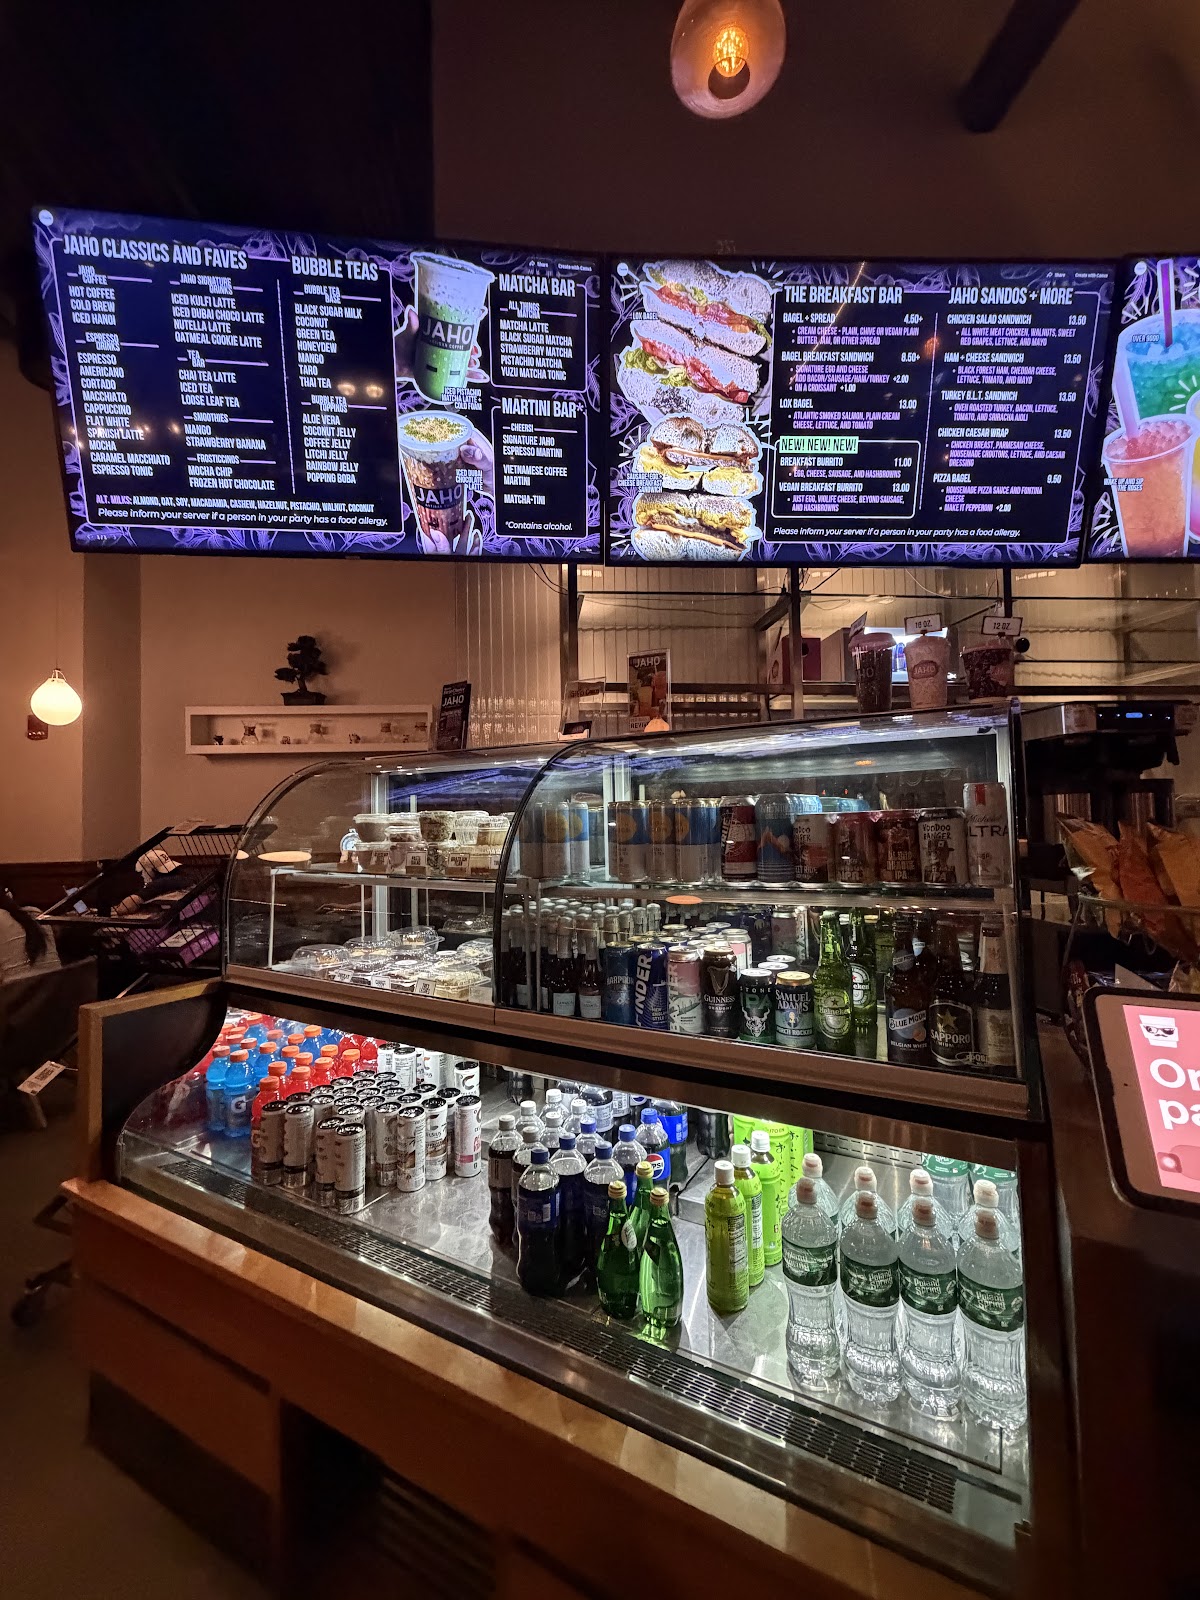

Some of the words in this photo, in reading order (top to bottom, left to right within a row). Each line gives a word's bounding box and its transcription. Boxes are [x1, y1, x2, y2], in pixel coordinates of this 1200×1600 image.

[64, 235, 99, 256] JAHO
[102, 238, 169, 262] CLASSICS
[173, 245, 201, 265] AND
[205, 248, 247, 270] FAVES
[292, 256, 343, 278] BUBBLE
[345, 261, 378, 281] TEAS
[499, 273, 549, 294] MATCHA
[551, 278, 575, 297] BAR
[69, 285, 84, 298] HOT
[86, 287, 115, 300] COFFEE
[784, 286, 807, 302] THE
[809, 286, 877, 303] BREAKFAST
[879, 287, 902, 304] BAR
[949, 287, 979, 304] JAHO
[981, 288, 1027, 304] SANDOS
[1039, 288, 1073, 305] MORE
[70, 299, 92, 311] COLD
[93, 301, 115, 313] BREW
[171, 293, 189, 305] ICED
[212, 297, 235, 309] LATTE
[172, 306, 190, 318] ICED
[192, 308, 214, 319] DUBAI
[215, 310, 240, 321] CHOCO
[241, 312, 265, 324] LATTE
[294, 303, 318, 315] BLACK
[320, 305, 343, 317] SUGAR
[344, 307, 362, 319] MILK
[72, 312, 92, 324] ICED
[93, 314, 116, 325] HANOI
[296, 315, 328, 328] COCONUT
[783, 313, 803, 323] BAGEL
[810, 314, 835, 323] SPREAD
[947, 314, 975, 324] CHICKEN
[976, 315, 996, 324] SALAD
[998, 315, 1031, 325] SANDWICH
[174, 319, 206, 332] NUTELLA
[208, 322, 231, 333] LATTE
[423, 318, 472, 345] JAHO
[500, 319, 527, 331] MATCHA
[529, 321, 548, 333] LATTE
[296, 328, 320, 340] GREEN
[321, 330, 335, 341] TEA
[297, 340, 336, 353] HONEYDEW
[78, 352, 117, 365] ESPRESSO
[298, 352, 324, 364] MANGO
[782, 352, 802, 361] BAGEL
[803, 352, 840, 362] BREAKFAST
[841, 353, 874, 362] SANDWICH
[944, 353, 959, 362] HAM
[966, 353, 990, 362] CHEESE
[991, 353, 1024, 363] SANDWICH
[80, 365, 124, 378] AMERICANO
[179, 369, 197, 380] CHAI
[198, 370, 213, 381] TEA
[213, 372, 236, 383] LATTE
[299, 364, 318, 376] TARO
[81, 378, 116, 389] CORTADO
[180, 382, 197, 392] ICED
[198, 383, 213, 394] TEA
[299, 376, 317, 388] THAI
[318, 378, 331, 388] TEA
[82, 390, 126, 403] MACCHIATO
[181, 394, 204, 405] LOOSE
[206, 395, 224, 406] LEAF
[225, 397, 240, 408] TEA
[84, 403, 131, 415] CAPPUCCINO
[502, 397, 550, 417] MARTINI
[780, 399, 792, 408] LOX
[793, 399, 813, 408] BAGEL
[85, 415, 105, 426] FLAT
[106, 416, 130, 427] WHITE
[185, 424, 211, 435] MANGO
[303, 425, 335, 436] COCONUT
[336, 427, 356, 438] JELLY
[511, 423, 533, 432] CHEERS!
[938, 428, 964, 437] CHICKEN
[966, 428, 990, 437] CAESAR
[991, 428, 1009, 438] WRAP
[89, 440, 117, 451] MOCHA
[186, 436, 235, 448] STRAWBERRY
[236, 438, 266, 450] BANANA
[304, 437, 330, 448] COFFEE
[331, 439, 351, 449] JELLY
[503, 435, 538, 445] SIGNATURE
[539, 437, 555, 446] JAHO
[781, 439, 804, 451] NEW!
[808, 439, 830, 451] NEW!
[833, 439, 857, 451] NEW!
[90, 451, 126, 463] CARAMEL
[128, 453, 170, 465] MACCHIATO
[503, 446, 535, 456] ESPRESSO
[536, 448, 562, 458] MARTINI
[780, 457, 816, 467] BREAKFAST
[817, 457, 843, 467] BURRITO
[894, 458, 912, 467] 11.00
[92, 464, 130, 475] ESPRESSO
[131, 466, 153, 476] TONIC
[188, 465, 214, 476] MOCHA
[216, 466, 232, 477] CHIP
[503, 464, 543, 475] VIETNAMESE
[544, 466, 567, 477] COFFEE
[189, 477, 217, 489] FROZEN
[218, 479, 233, 489] HOT
[234, 479, 275, 491] CHOCOLATE
[504, 476, 530, 486] MARTINI
[933, 474, 950, 482] PIZZA
[952, 474, 971, 483] BAGEL
[416, 485, 462, 504] JAHO
[544, 523, 572, 531] alcohol.
[635, 656, 660, 668] JAHO
[913, 665, 936, 675] JAHO
[442, 695, 464, 707] JAHO
[968, 826, 1009, 836] LTRA
[635, 954, 653, 1026] INDER
[776, 990, 811, 1002] SAMUEL
[704, 994, 735, 1002] GUINNESS
[778, 1001, 808, 1012] ADAMS
[889, 1016, 907, 1029] BLUE
[909, 1011, 926, 1023] MOON
[931, 1029, 970, 1043] SAPPORO
[914, 1277, 940, 1287] Poland
[976, 1291, 1004, 1300] Poland
